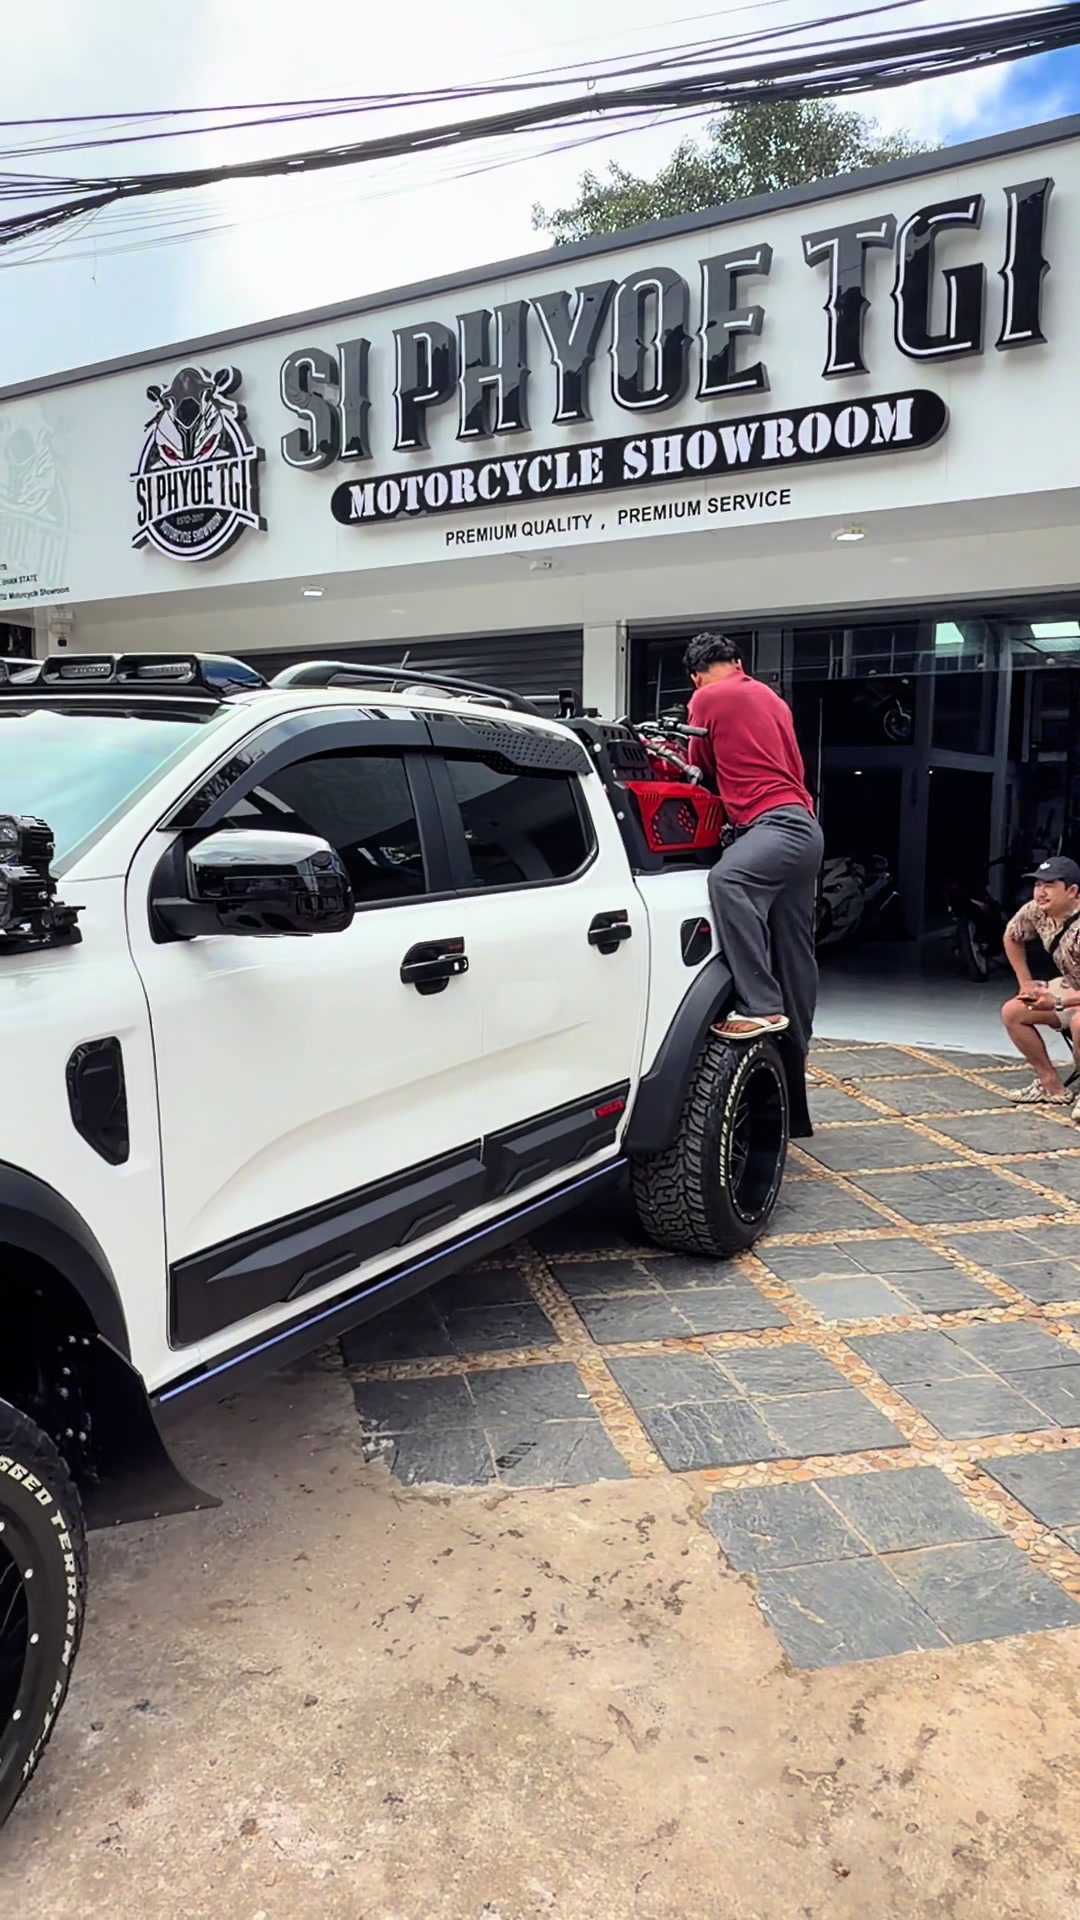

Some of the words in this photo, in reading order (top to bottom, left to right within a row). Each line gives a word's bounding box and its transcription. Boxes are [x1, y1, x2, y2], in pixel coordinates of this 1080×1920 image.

[280, 338, 373, 472] SI
[393, 243, 773, 454] PHYOE
[801, 177, 1055, 380] TGI
[136, 476, 153, 527] SI
[156, 464, 214, 516] PHYOE
[217, 460, 248, 512] TGI
[348, 446, 604, 518] MOTORCYCLE
[622, 398, 914, 481] SHOWROOM
[445, 524, 518, 547] PREMIUM
[522, 514, 593, 536] QUALITY
[617, 500, 701, 525] PREMIUM
[707, 489, 792, 514] SERVICE
[50, 1509, 77, 1666] TERRAIN
